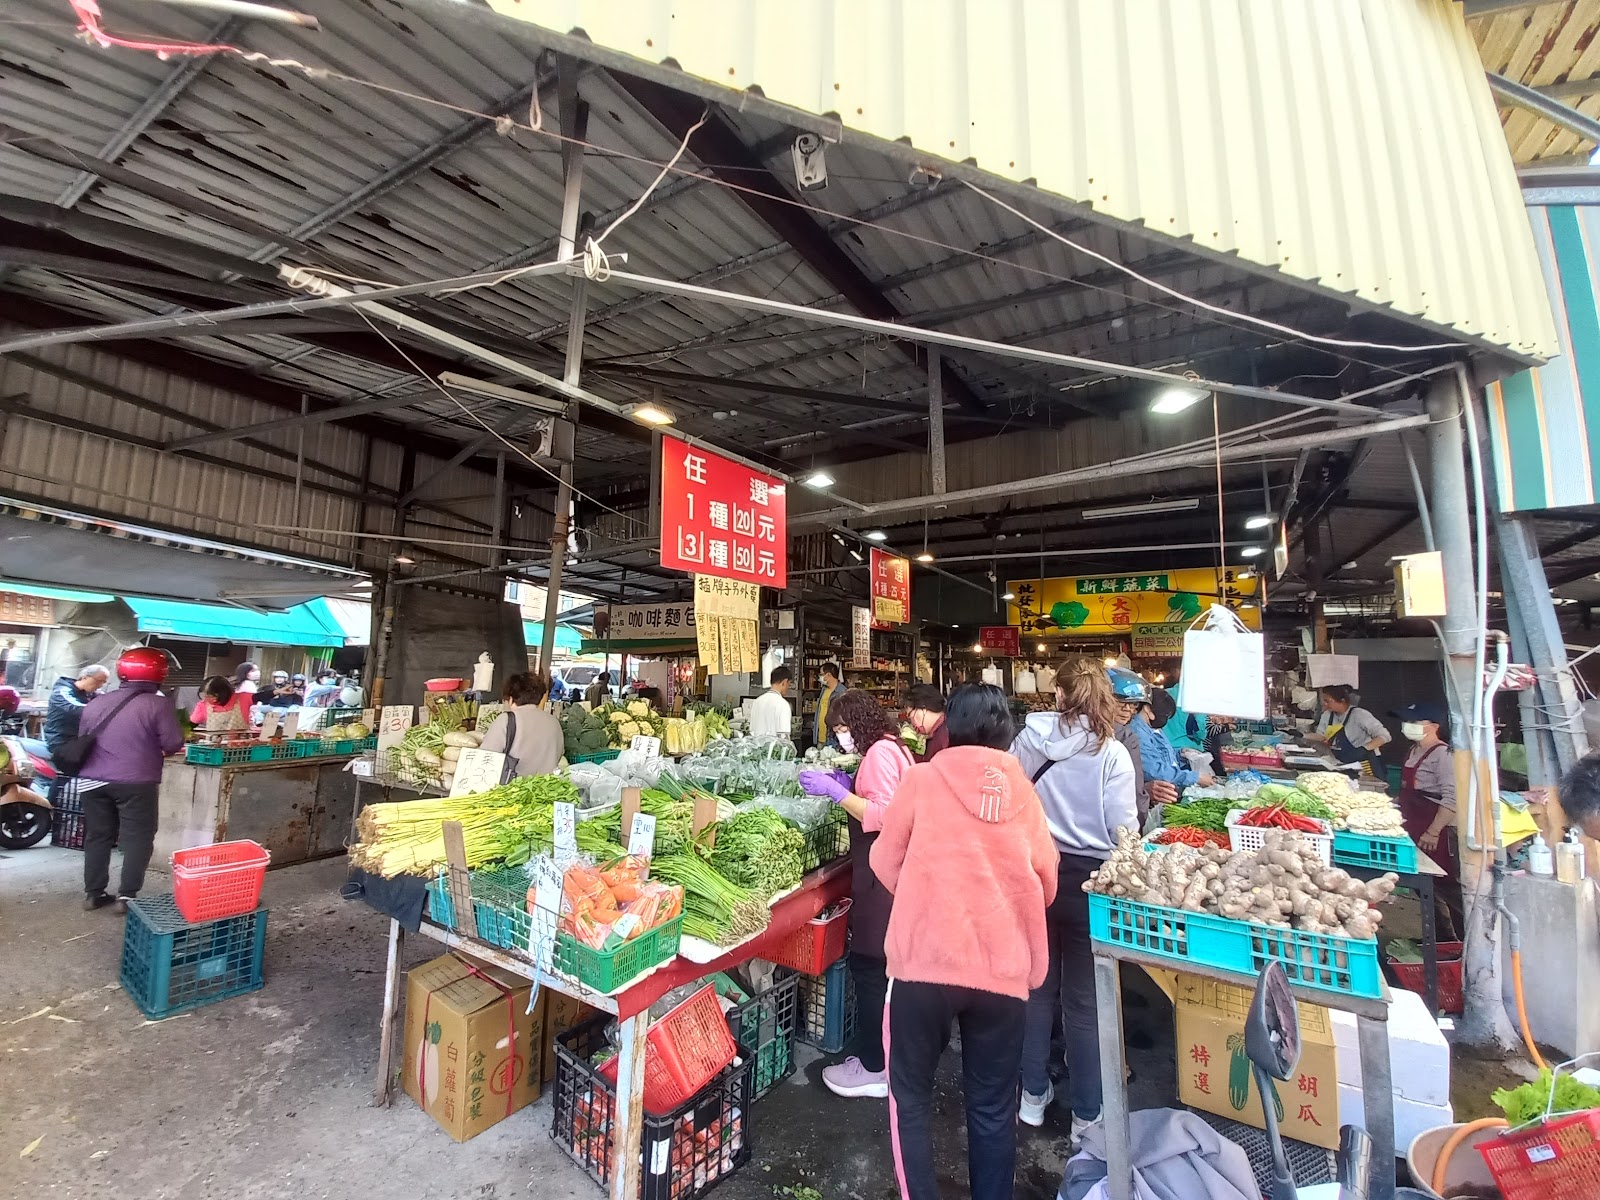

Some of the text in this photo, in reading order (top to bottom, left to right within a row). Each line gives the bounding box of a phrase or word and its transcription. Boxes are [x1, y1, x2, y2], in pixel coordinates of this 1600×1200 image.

[683, 452, 769, 506] 任選
[686, 492, 776, 543] 1種20元
[683, 532, 776, 578] 3種50元
[877, 559, 904, 583] 任選
[1080, 576, 1164, 594] 新鮮蔬菜
[628, 607, 696, 628] 咖啡麵包
[1111, 596, 1132, 626] 大頭
[390, 718, 412, 732] 30
[444, 1041, 459, 1123] 白蘿蔔
[1189, 1044, 1211, 1095] 特選
[1297, 1073, 1322, 1127] 胡瓜
